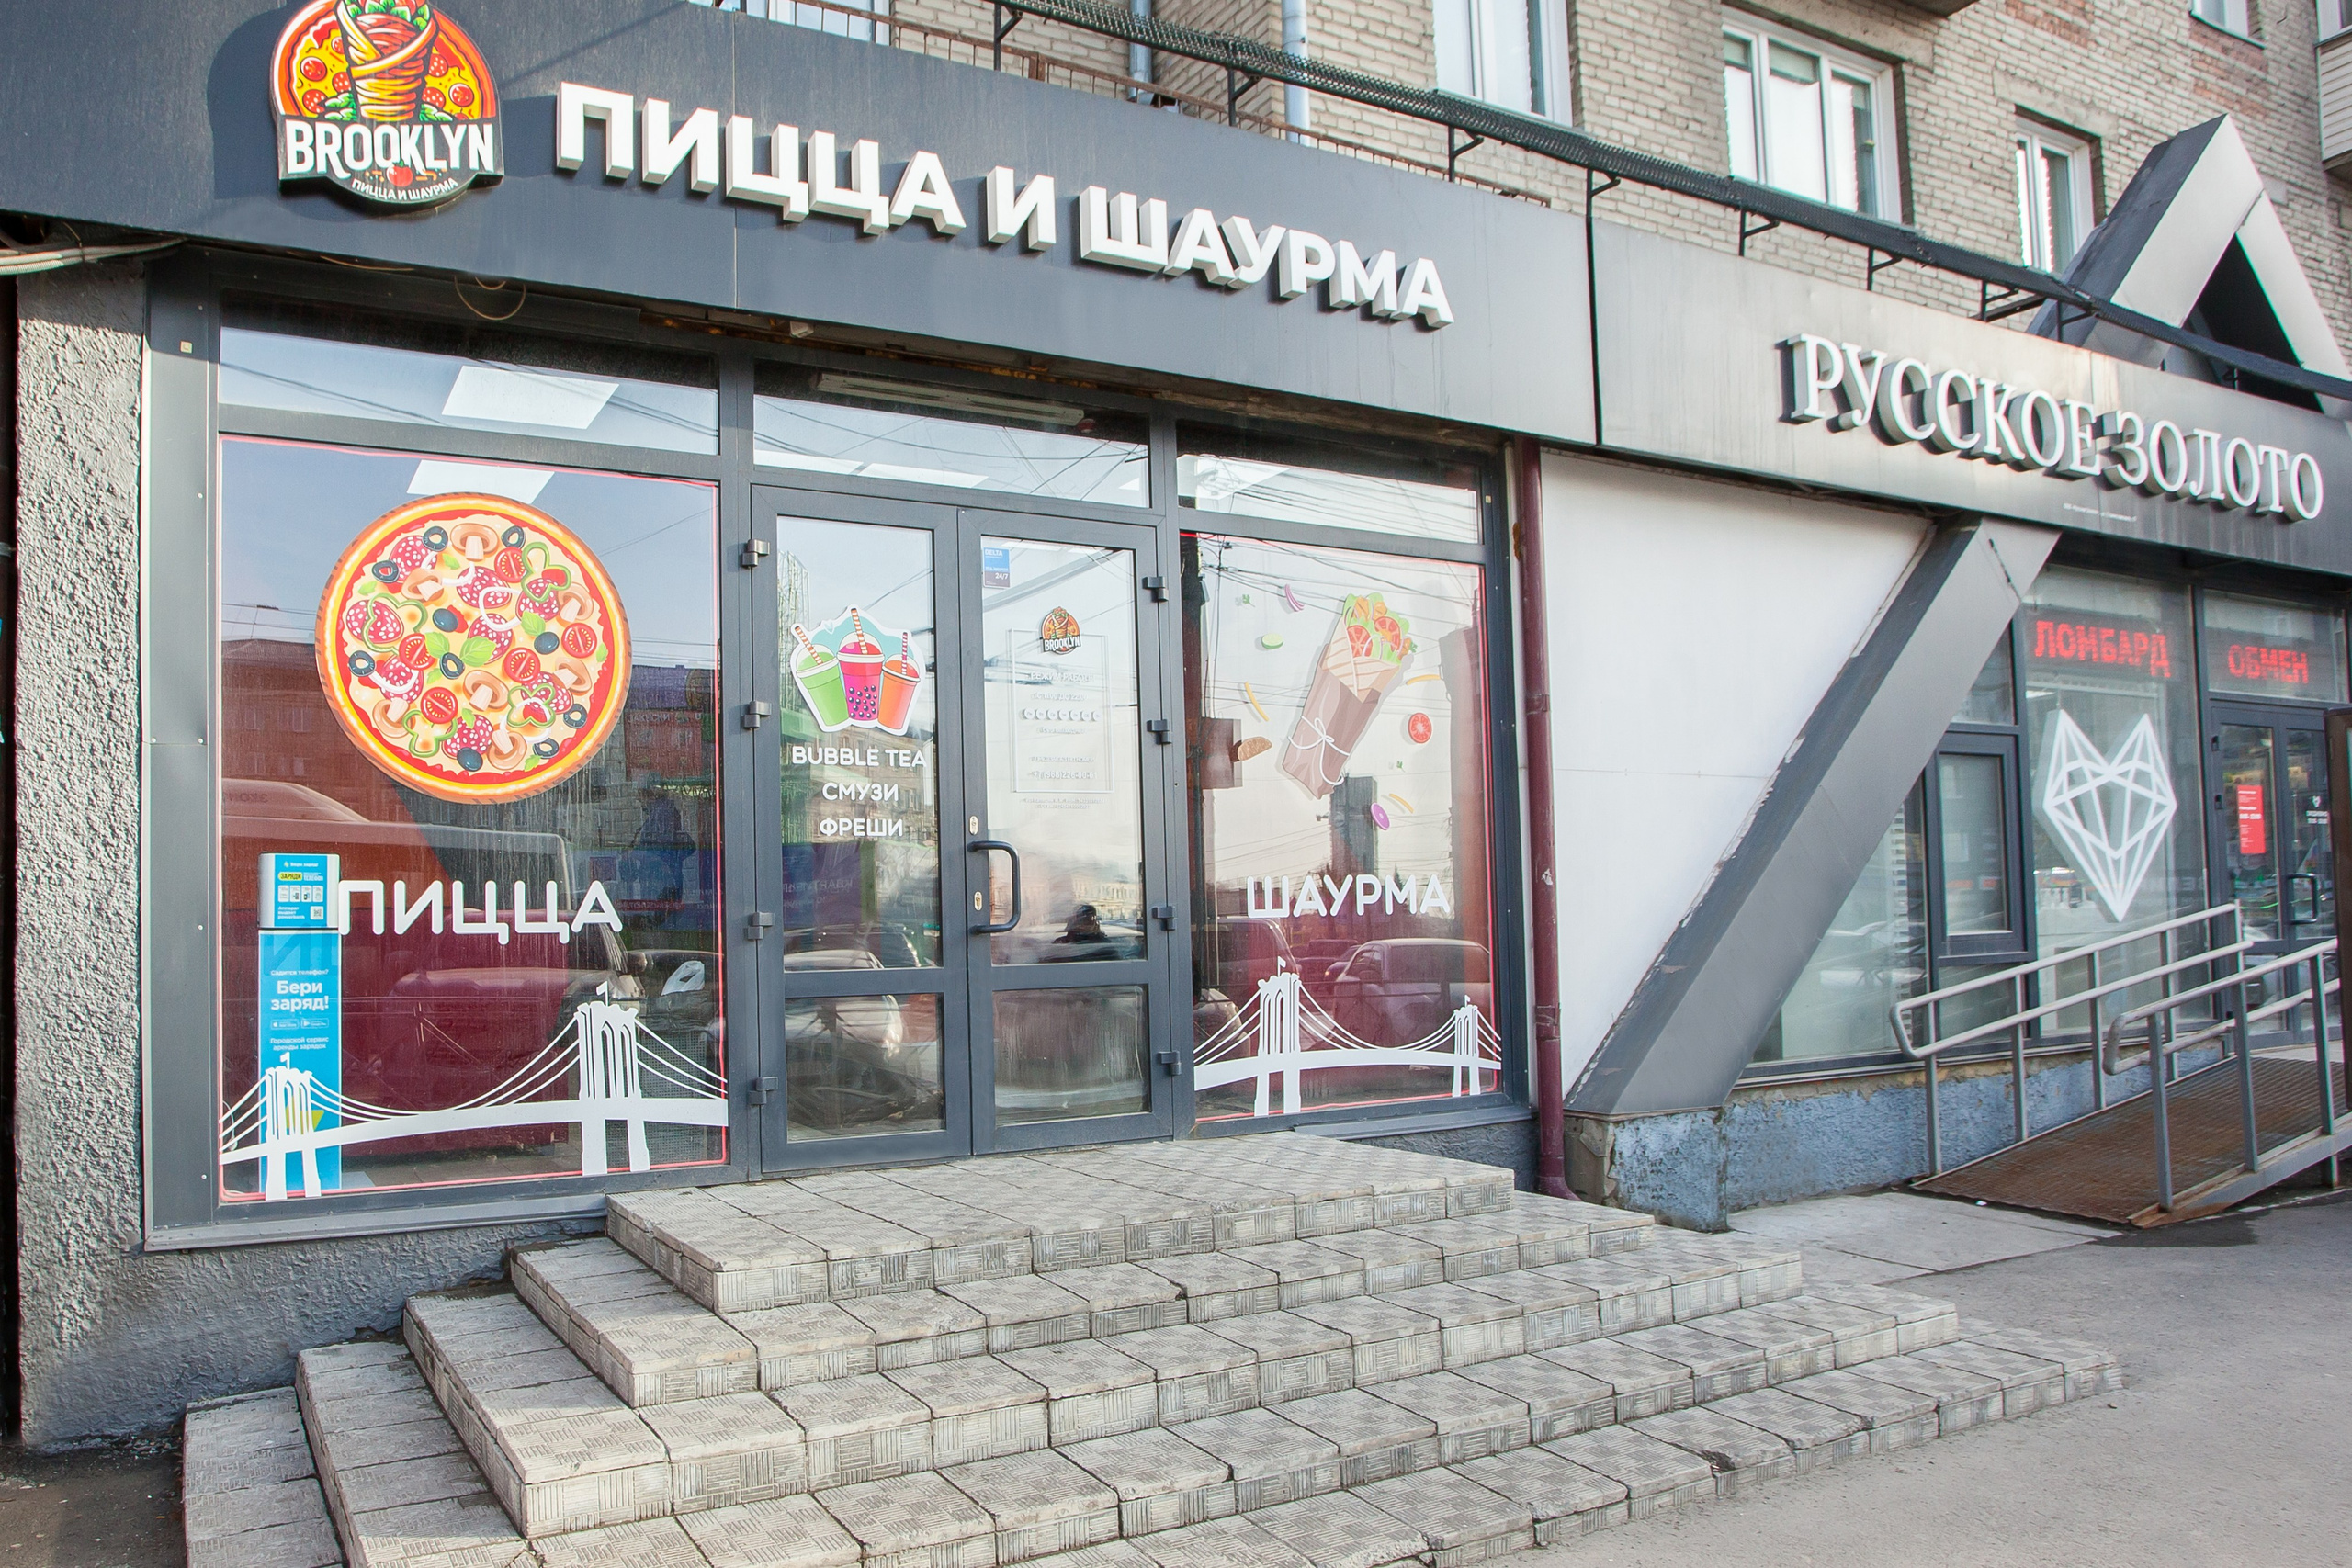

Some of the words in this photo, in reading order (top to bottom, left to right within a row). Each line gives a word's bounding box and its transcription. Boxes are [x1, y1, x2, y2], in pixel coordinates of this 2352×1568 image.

[284, 119, 495, 179] BROOKLYN
[351, 178, 397, 200] ПИЦЦА
[397, 189, 408, 200] И
[408, 177, 458, 200] ШАУРМА
[556, 81, 967, 235] ПИЦЦА
[986, 165, 1056, 252] И
[1079, 185, 1455, 330] ШАУРМА
[1787, 333, 2101, 478] РУССКОЕ
[2102, 410, 2324, 522] ЗОЛОТО
[984, 548, 1003, 557] DELTA
[1044, 636, 1080, 651] BROOKLYN
[2034, 620, 2171, 679] ЛОМБАРД
[2227, 643, 2310, 685] ОБМЕН
[792, 745, 879, 767] BUBBLE
[885, 749, 927, 768] TEA
[821, 782, 899, 802] СМУЗИ
[820, 817, 903, 837] ФРЕШИ
[1247, 874, 1451, 919] ШАУРМА
[338, 880, 623, 945] ПИЦЦА
[277, 980, 322, 997] Бери
[270, 995, 329, 1012] заряд!
